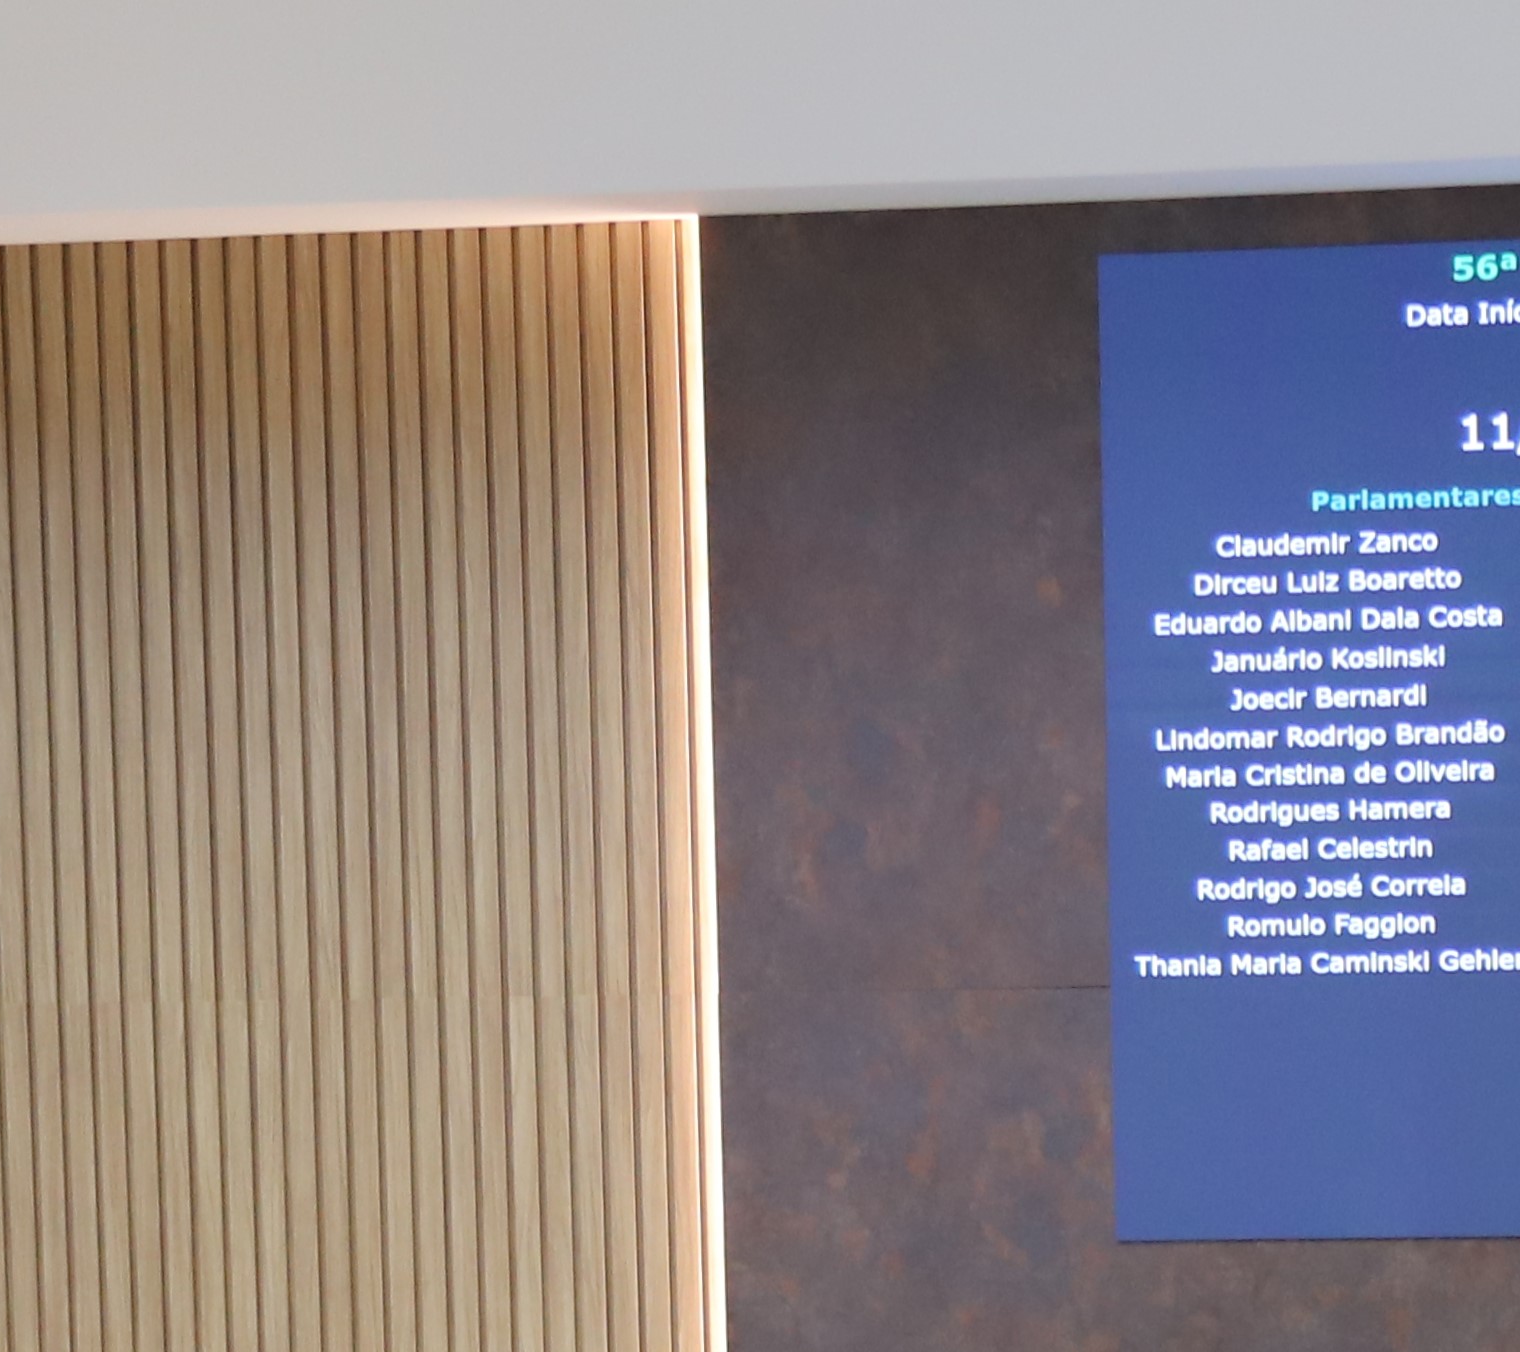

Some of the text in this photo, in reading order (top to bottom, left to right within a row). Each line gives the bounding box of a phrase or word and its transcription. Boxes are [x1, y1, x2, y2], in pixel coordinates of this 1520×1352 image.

[1451, 250, 1519, 283] 56ª
[1404, 301, 1470, 329] Data
[1213, 528, 1440, 559] Claudemir Zanco
[1192, 565, 1464, 598] Dirceu Luiz Boaretto
[1152, 602, 1504, 638] Eduardo Albani Dala Costa
[1209, 644, 1325, 675] Januário
[1228, 681, 1428, 713] Joecir Bernardi
[1153, 717, 1507, 753] Lindomar Rodrigo Brandão
[1163, 757, 1496, 790] Maria Cristina de Oliveira
[1208, 796, 1452, 829] Rodrigues Hamera
[1226, 834, 1434, 863] Rafael Celestrin
[1195, 871, 1468, 906] Rodrigo José Correia
[1225, 910, 1437, 941] Romulo Faggion
[1132, 952, 1223, 979] Thania
[1228, 951, 1303, 977] Maria
[1308, 948, 1431, 976] Caminski
